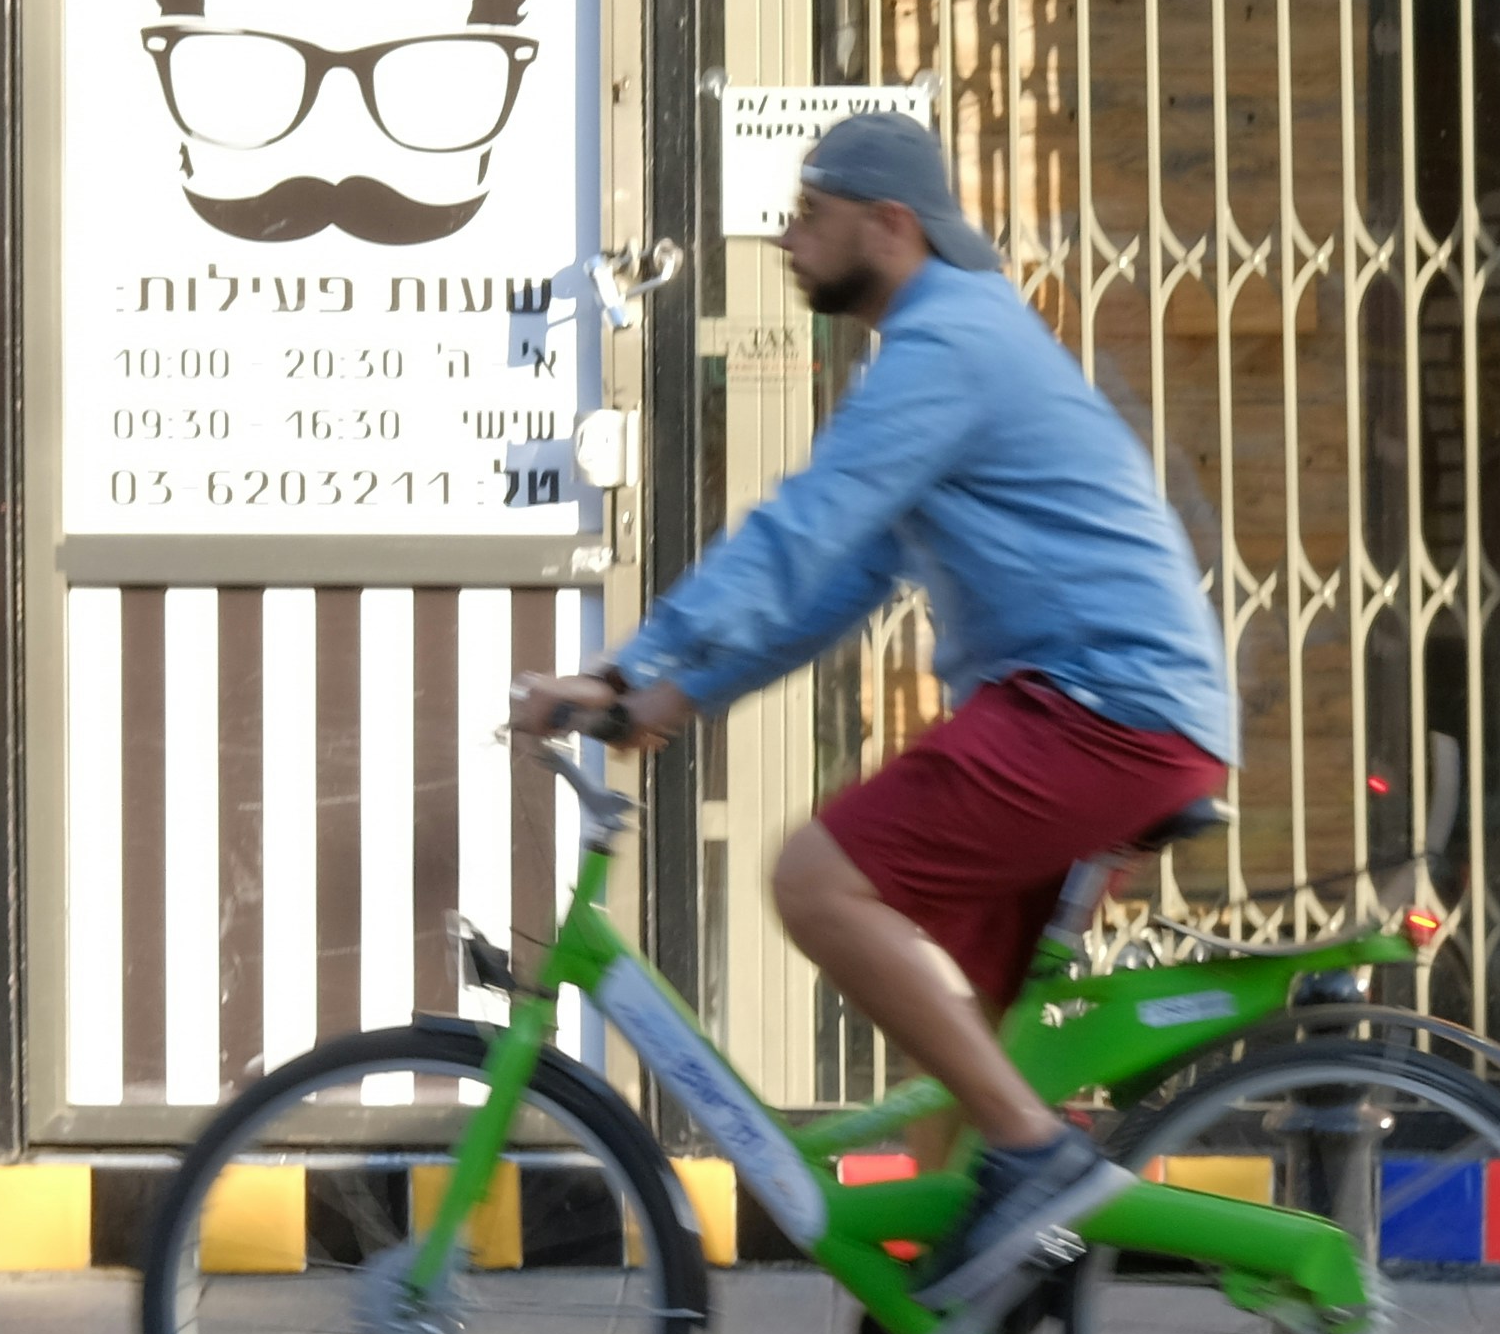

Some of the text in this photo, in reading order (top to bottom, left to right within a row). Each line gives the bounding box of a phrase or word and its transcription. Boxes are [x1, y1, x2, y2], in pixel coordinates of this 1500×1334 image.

[116, 264, 552, 313] שעות פעילות:
[113, 348, 230, 379] 10:00
[284, 348, 404, 379] 20:30
[113, 409, 230, 440] 09:30
[285, 409, 401, 440] 16:30
[462, 410, 556, 440] שישי
[111, 470, 451, 505] 03-6203211
